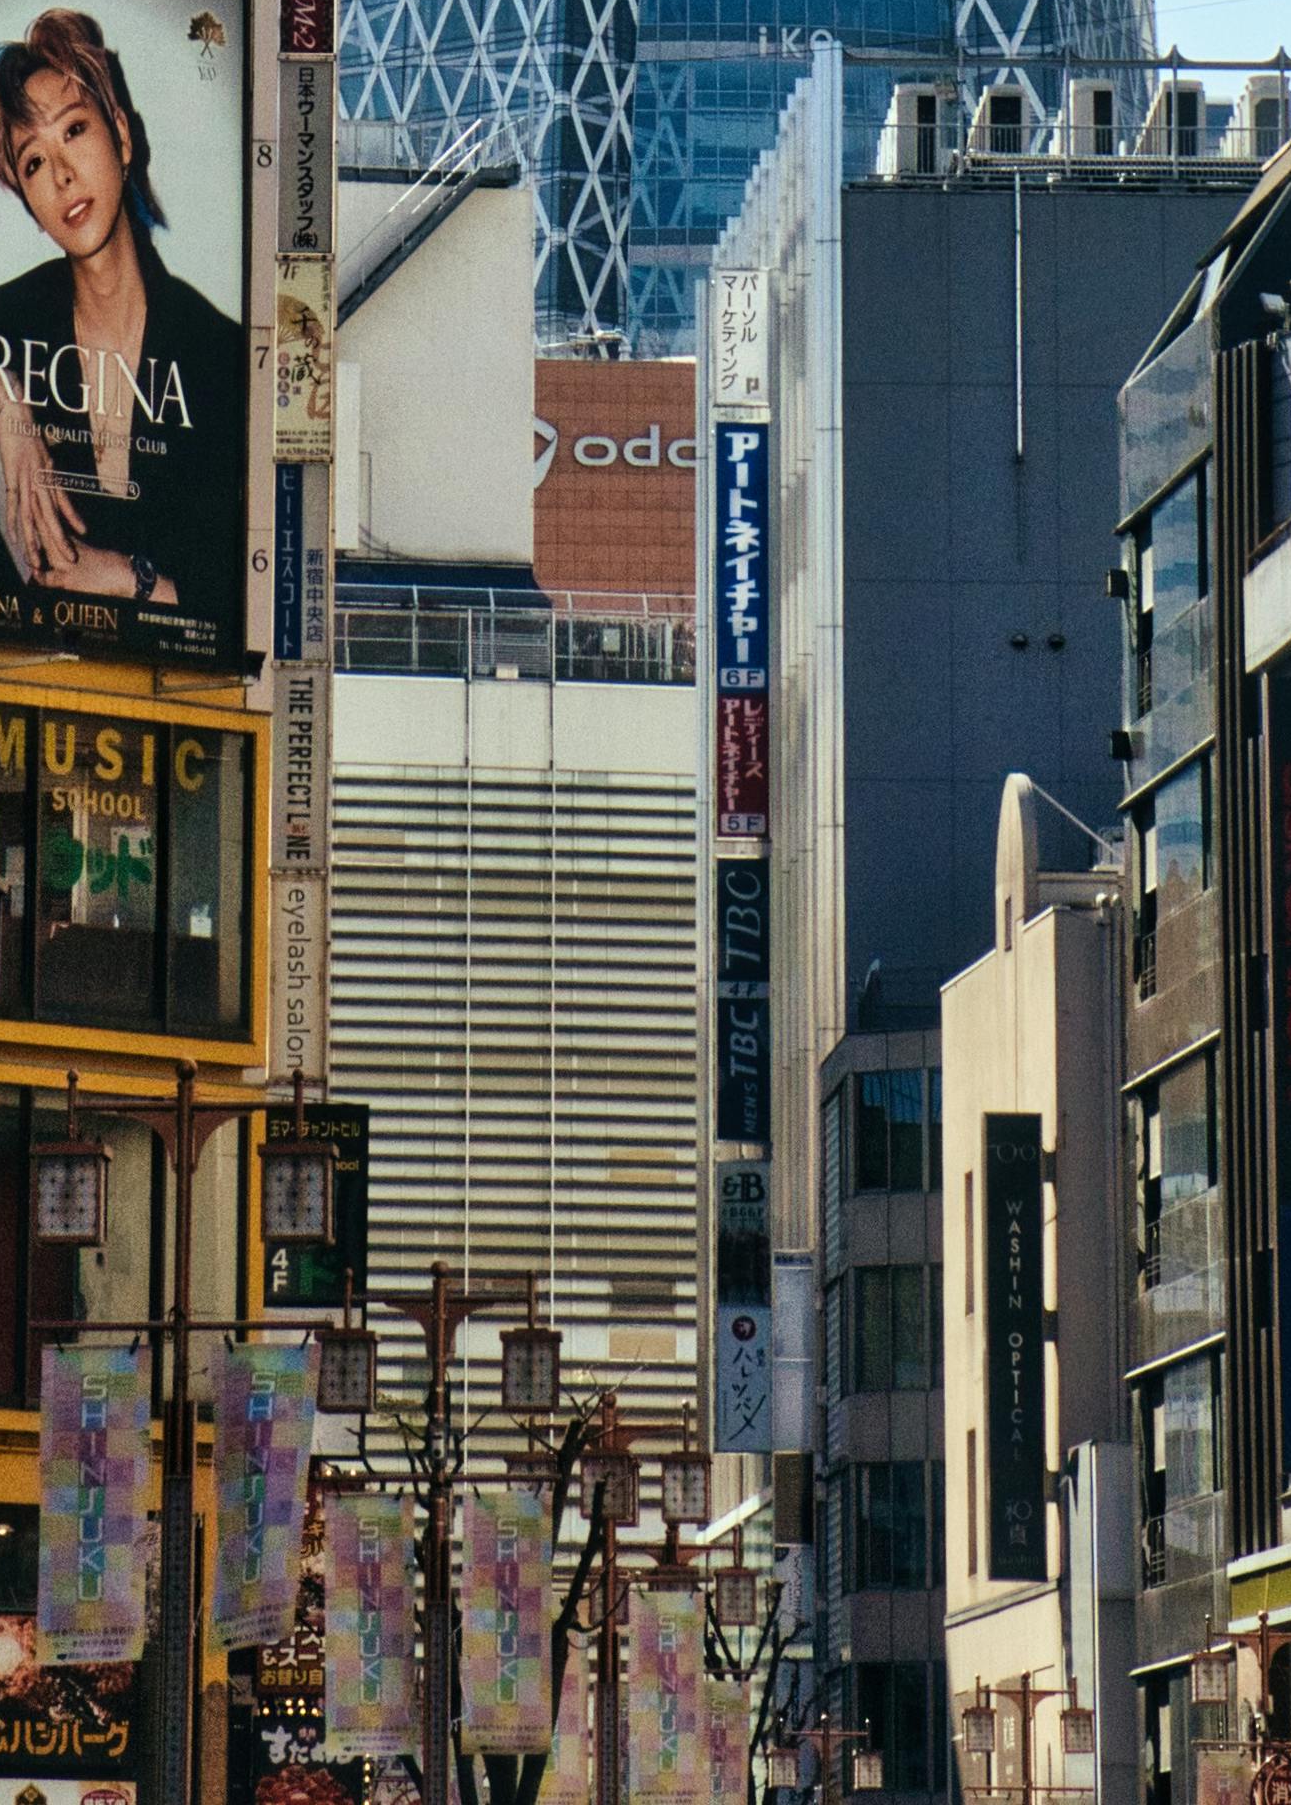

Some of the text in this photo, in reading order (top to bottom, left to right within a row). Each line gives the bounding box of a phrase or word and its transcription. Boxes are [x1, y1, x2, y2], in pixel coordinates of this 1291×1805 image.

[257, 144, 272, 169] 8
[721, 275, 738, 390] マーケティング
[741, 274, 758, 343] パーソル
[255, 346, 269, 369] 7
[45, 422, 96, 446] QUALITY
[136, 437, 168, 456] CLUB
[252, 548, 269, 573] 6
[281, 469, 295, 656] ビー・エスコート
[725, 432, 760, 663] アートネイチャー
[32, 607, 43, 625] &
[54, 600, 119, 630] QUEEN
[306, 549, 324, 642] 新宿中央店
[289, 676, 314, 714] THE
[726, 670, 760, 686] 6F
[286, 721, 313, 809] PERFECT
[743, 698, 764, 779] レディース
[52, 785, 144, 821] SCHOOL
[728, 816, 760, 832] 5F
[725, 871, 761, 969] TBC
[286, 888, 313, 1070] eyelash salon
[730, 1005, 759, 1077] TBC
[1005, 1200, 1024, 1462] WASHIN OPTICAL
[81, 1374, 110, 1602] SHINJUKU
